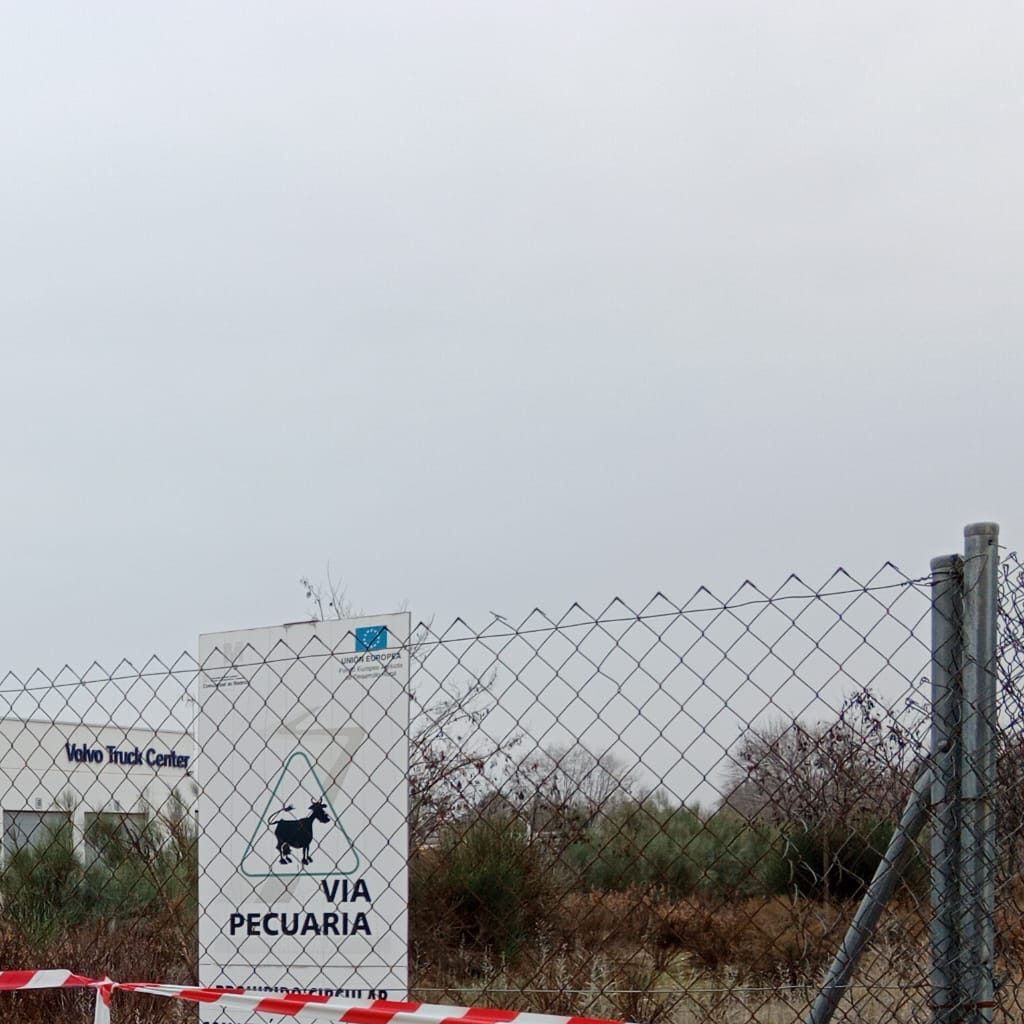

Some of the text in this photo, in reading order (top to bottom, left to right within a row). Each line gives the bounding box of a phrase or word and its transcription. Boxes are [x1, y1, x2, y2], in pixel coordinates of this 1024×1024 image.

[65, 742, 190, 769] Volvo Truck Center
[321, 878, 372, 903] VIA
[229, 911, 372, 936] PECUARIA
